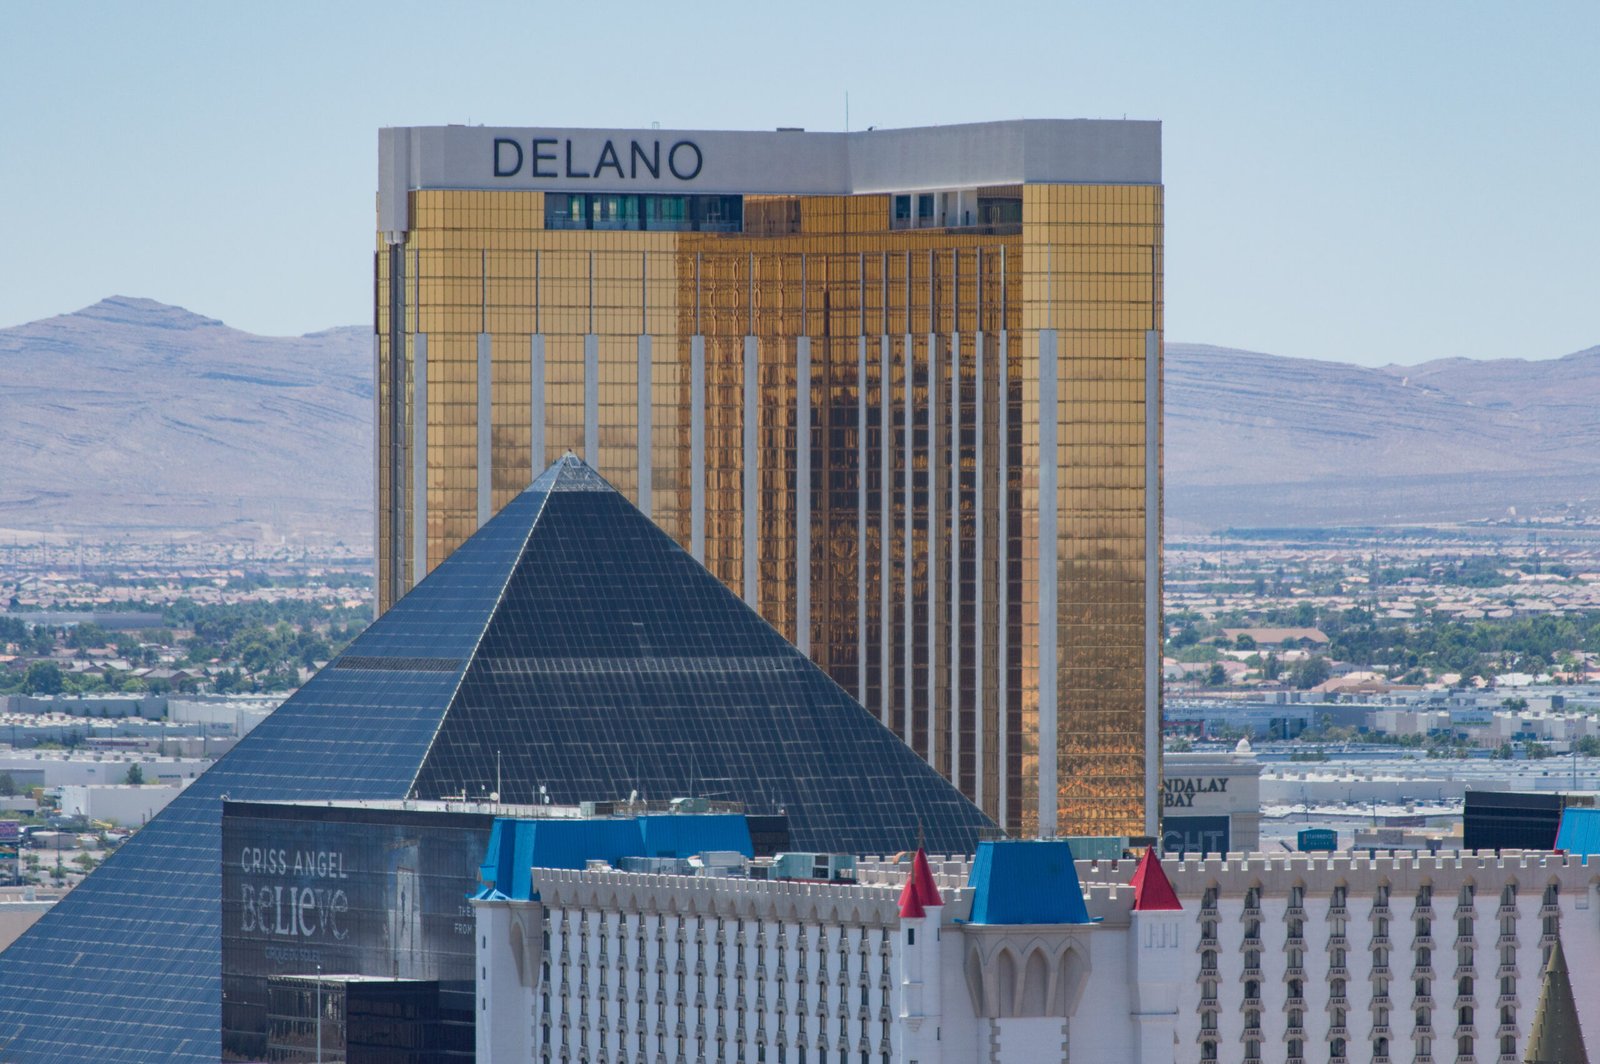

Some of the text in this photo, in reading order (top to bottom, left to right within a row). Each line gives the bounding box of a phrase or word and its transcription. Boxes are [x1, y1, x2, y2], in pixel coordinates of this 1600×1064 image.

[493, 138, 703, 181] DELANO
[1164, 793, 1196, 807] BAY
[241, 847, 348, 879] CRISS ANGEL
[454, 922, 472, 935] FROM
